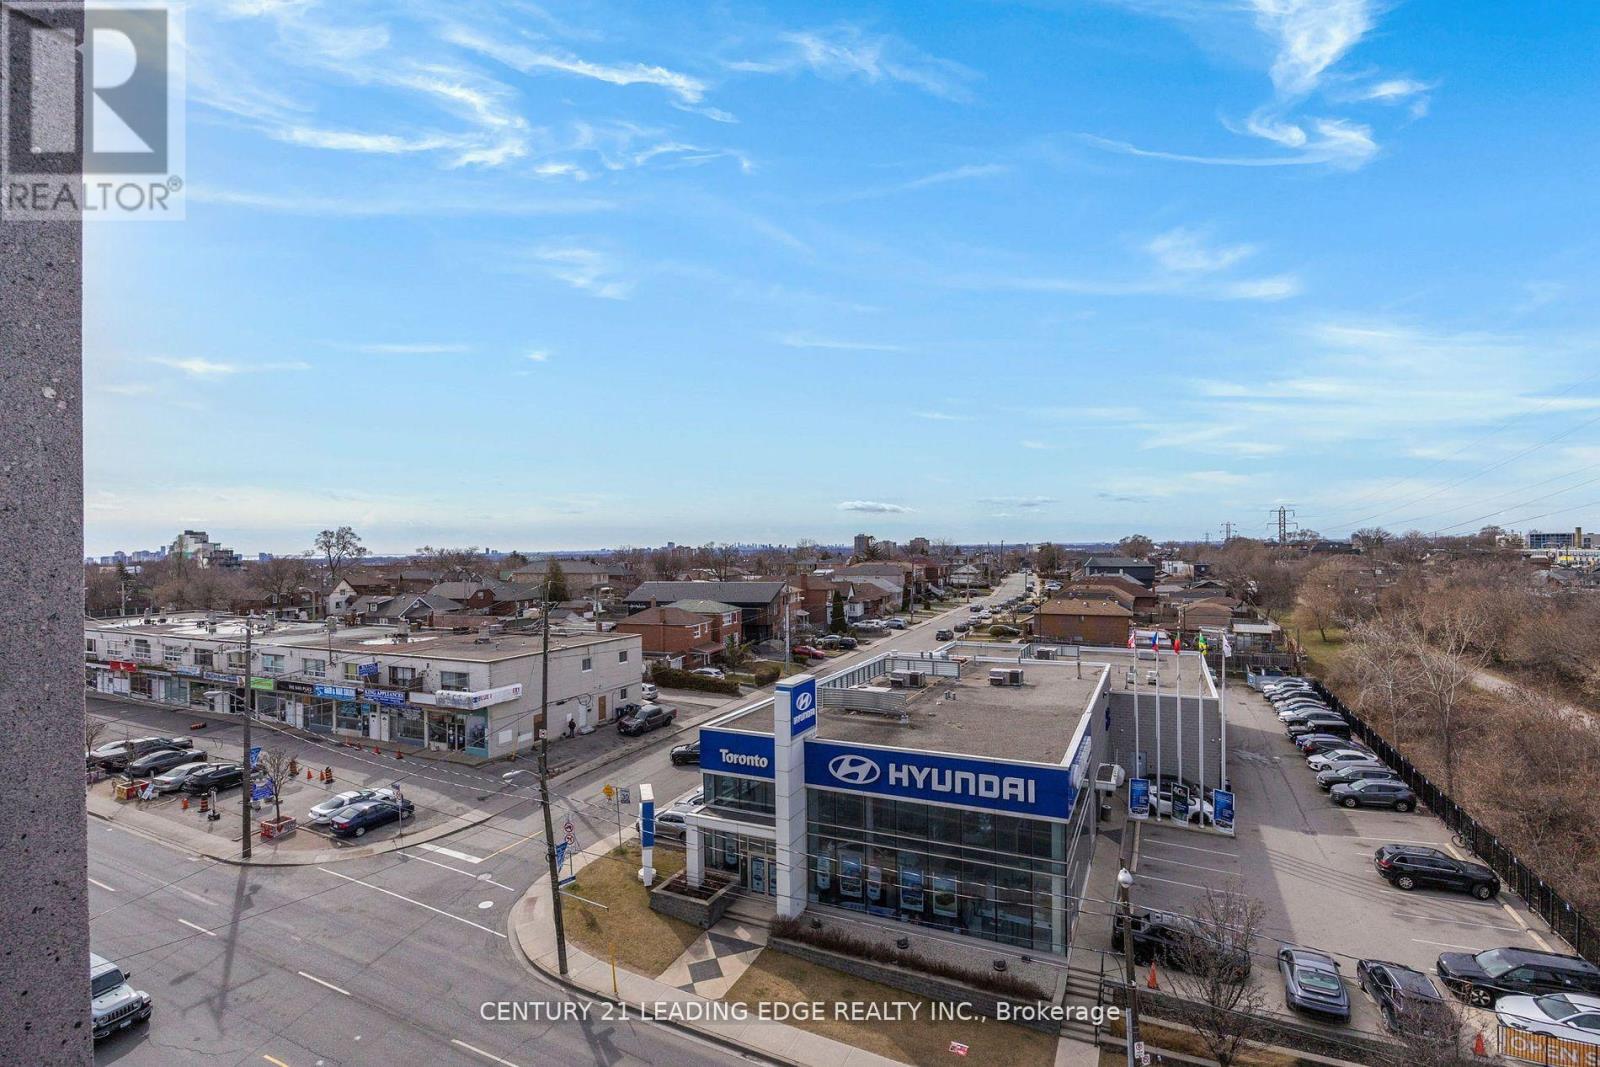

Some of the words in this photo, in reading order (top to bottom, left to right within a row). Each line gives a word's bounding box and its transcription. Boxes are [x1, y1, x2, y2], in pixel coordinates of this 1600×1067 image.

[794, 708, 816, 726] HYUNDAI
[719, 748, 769, 769] Toronto
[888, 763, 1036, 804] HYUNDAI
[1510, 1036, 1579, 1062] OPEN
